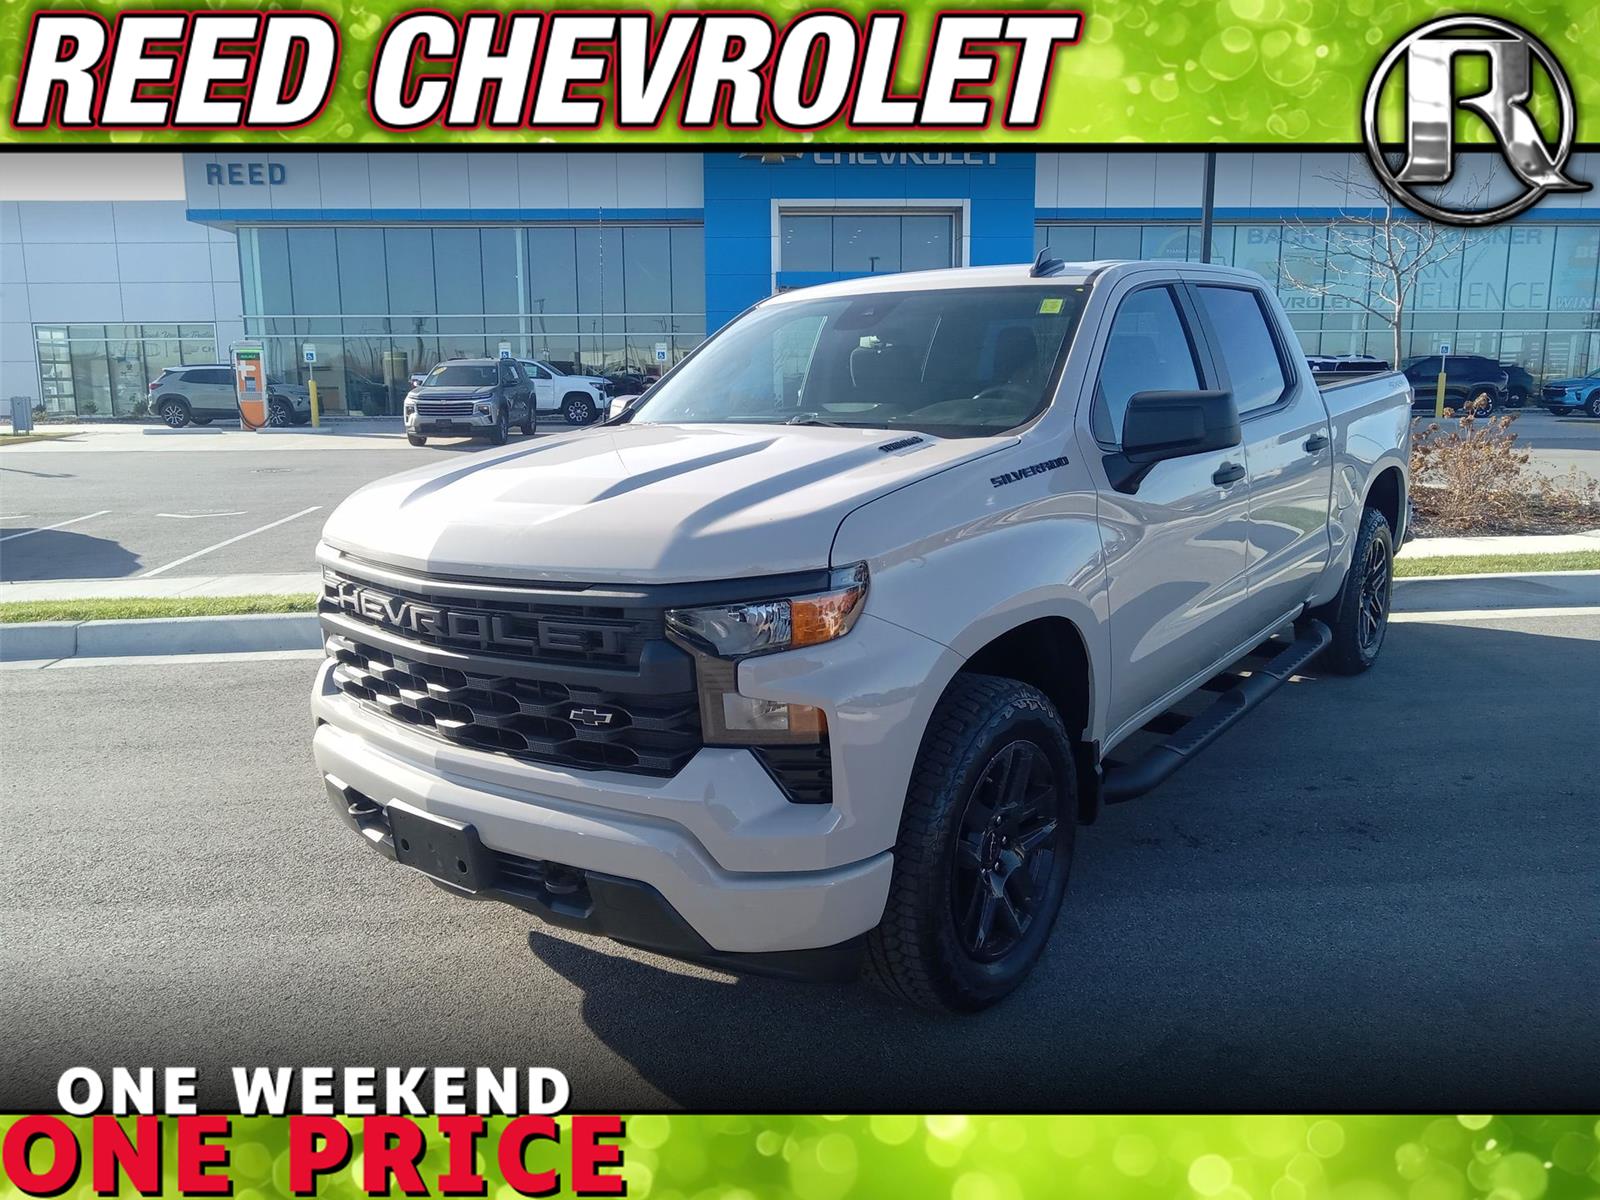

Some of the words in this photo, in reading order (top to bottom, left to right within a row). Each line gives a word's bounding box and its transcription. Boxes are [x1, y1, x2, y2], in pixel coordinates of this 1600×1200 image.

[206, 163, 286, 185] REED
[990, 455, 1070, 488] SILVERADO
[322, 571, 643, 654] CHEVROLET
